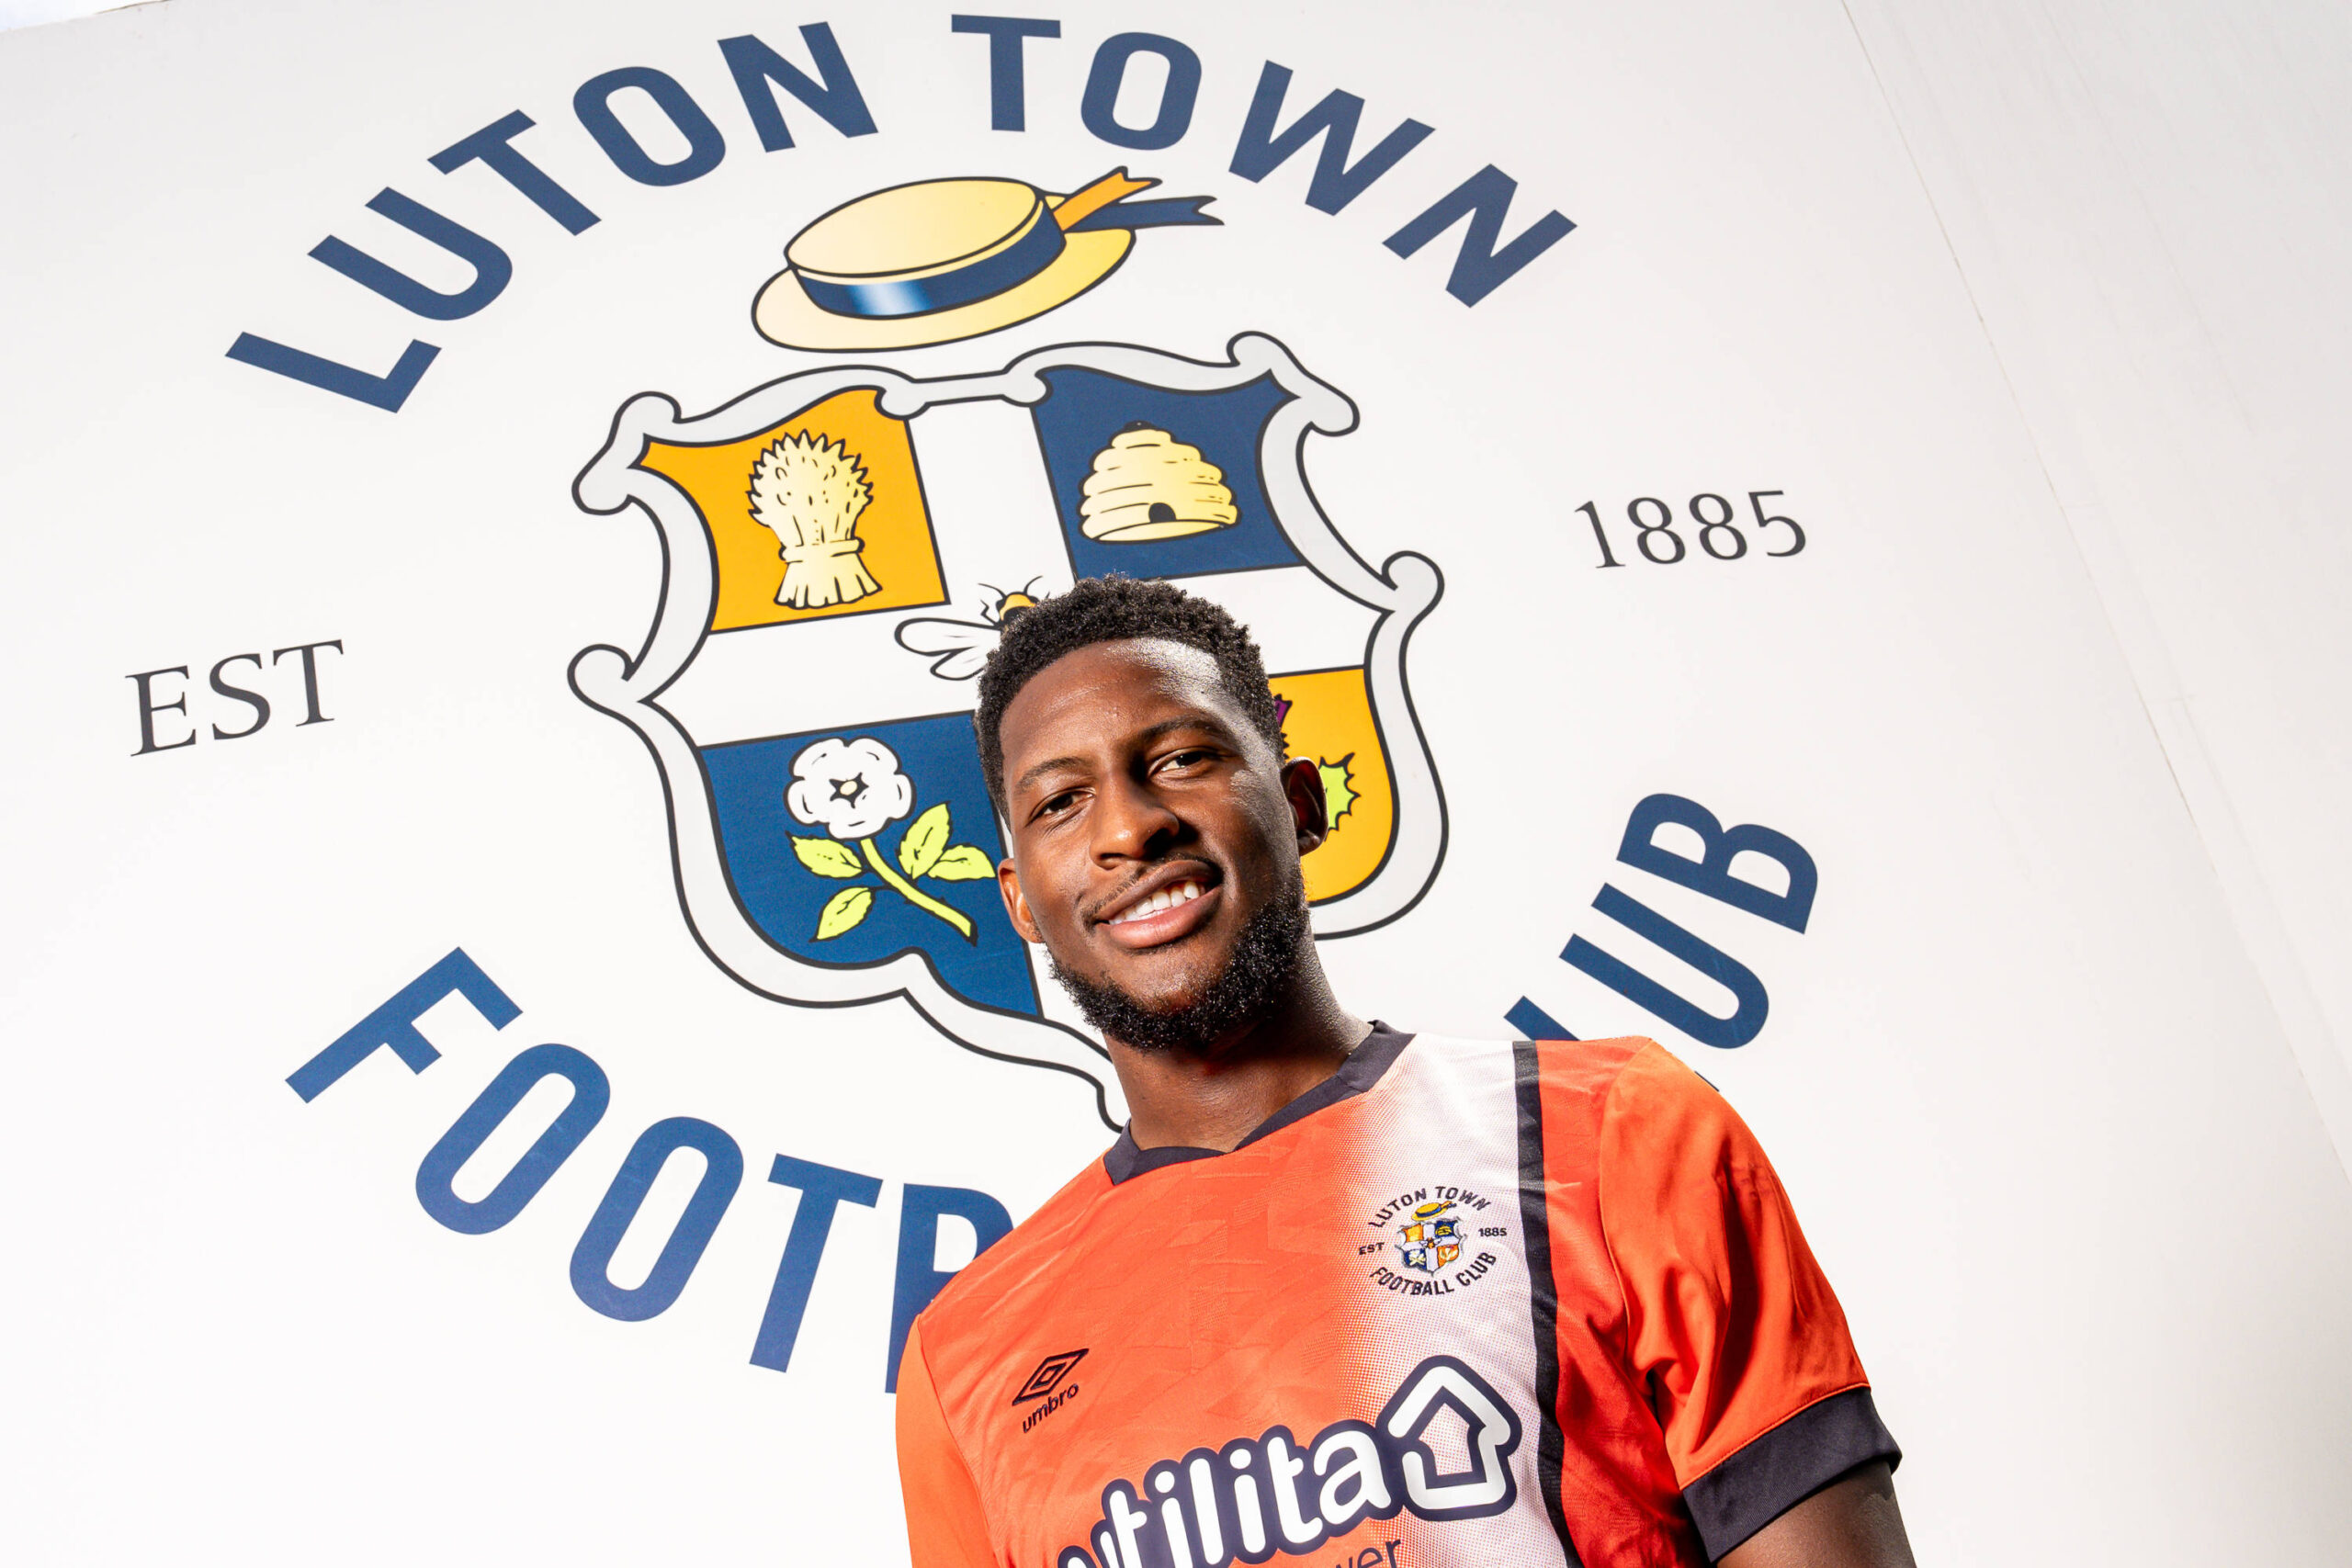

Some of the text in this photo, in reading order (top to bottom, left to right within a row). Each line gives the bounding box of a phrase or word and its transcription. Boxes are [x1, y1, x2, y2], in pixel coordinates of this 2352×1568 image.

[225, 14, 1577, 413] LUTON TOWN
[1574, 490, 1807, 570] 1885
[125, 639, 344, 757] EST
[1503, 793, 1819, 1049] UB
[1368, 1186, 1491, 1228] LUTON TOWN
[1478, 1227, 1508, 1237] 1885
[1359, 1242, 1385, 1255] EST
[1369, 1252, 1497, 1296] FOOTBALL CLUB
[1023, 1383, 1080, 1433] umbro
[1064, 1427, 1392, 1568] tilita
